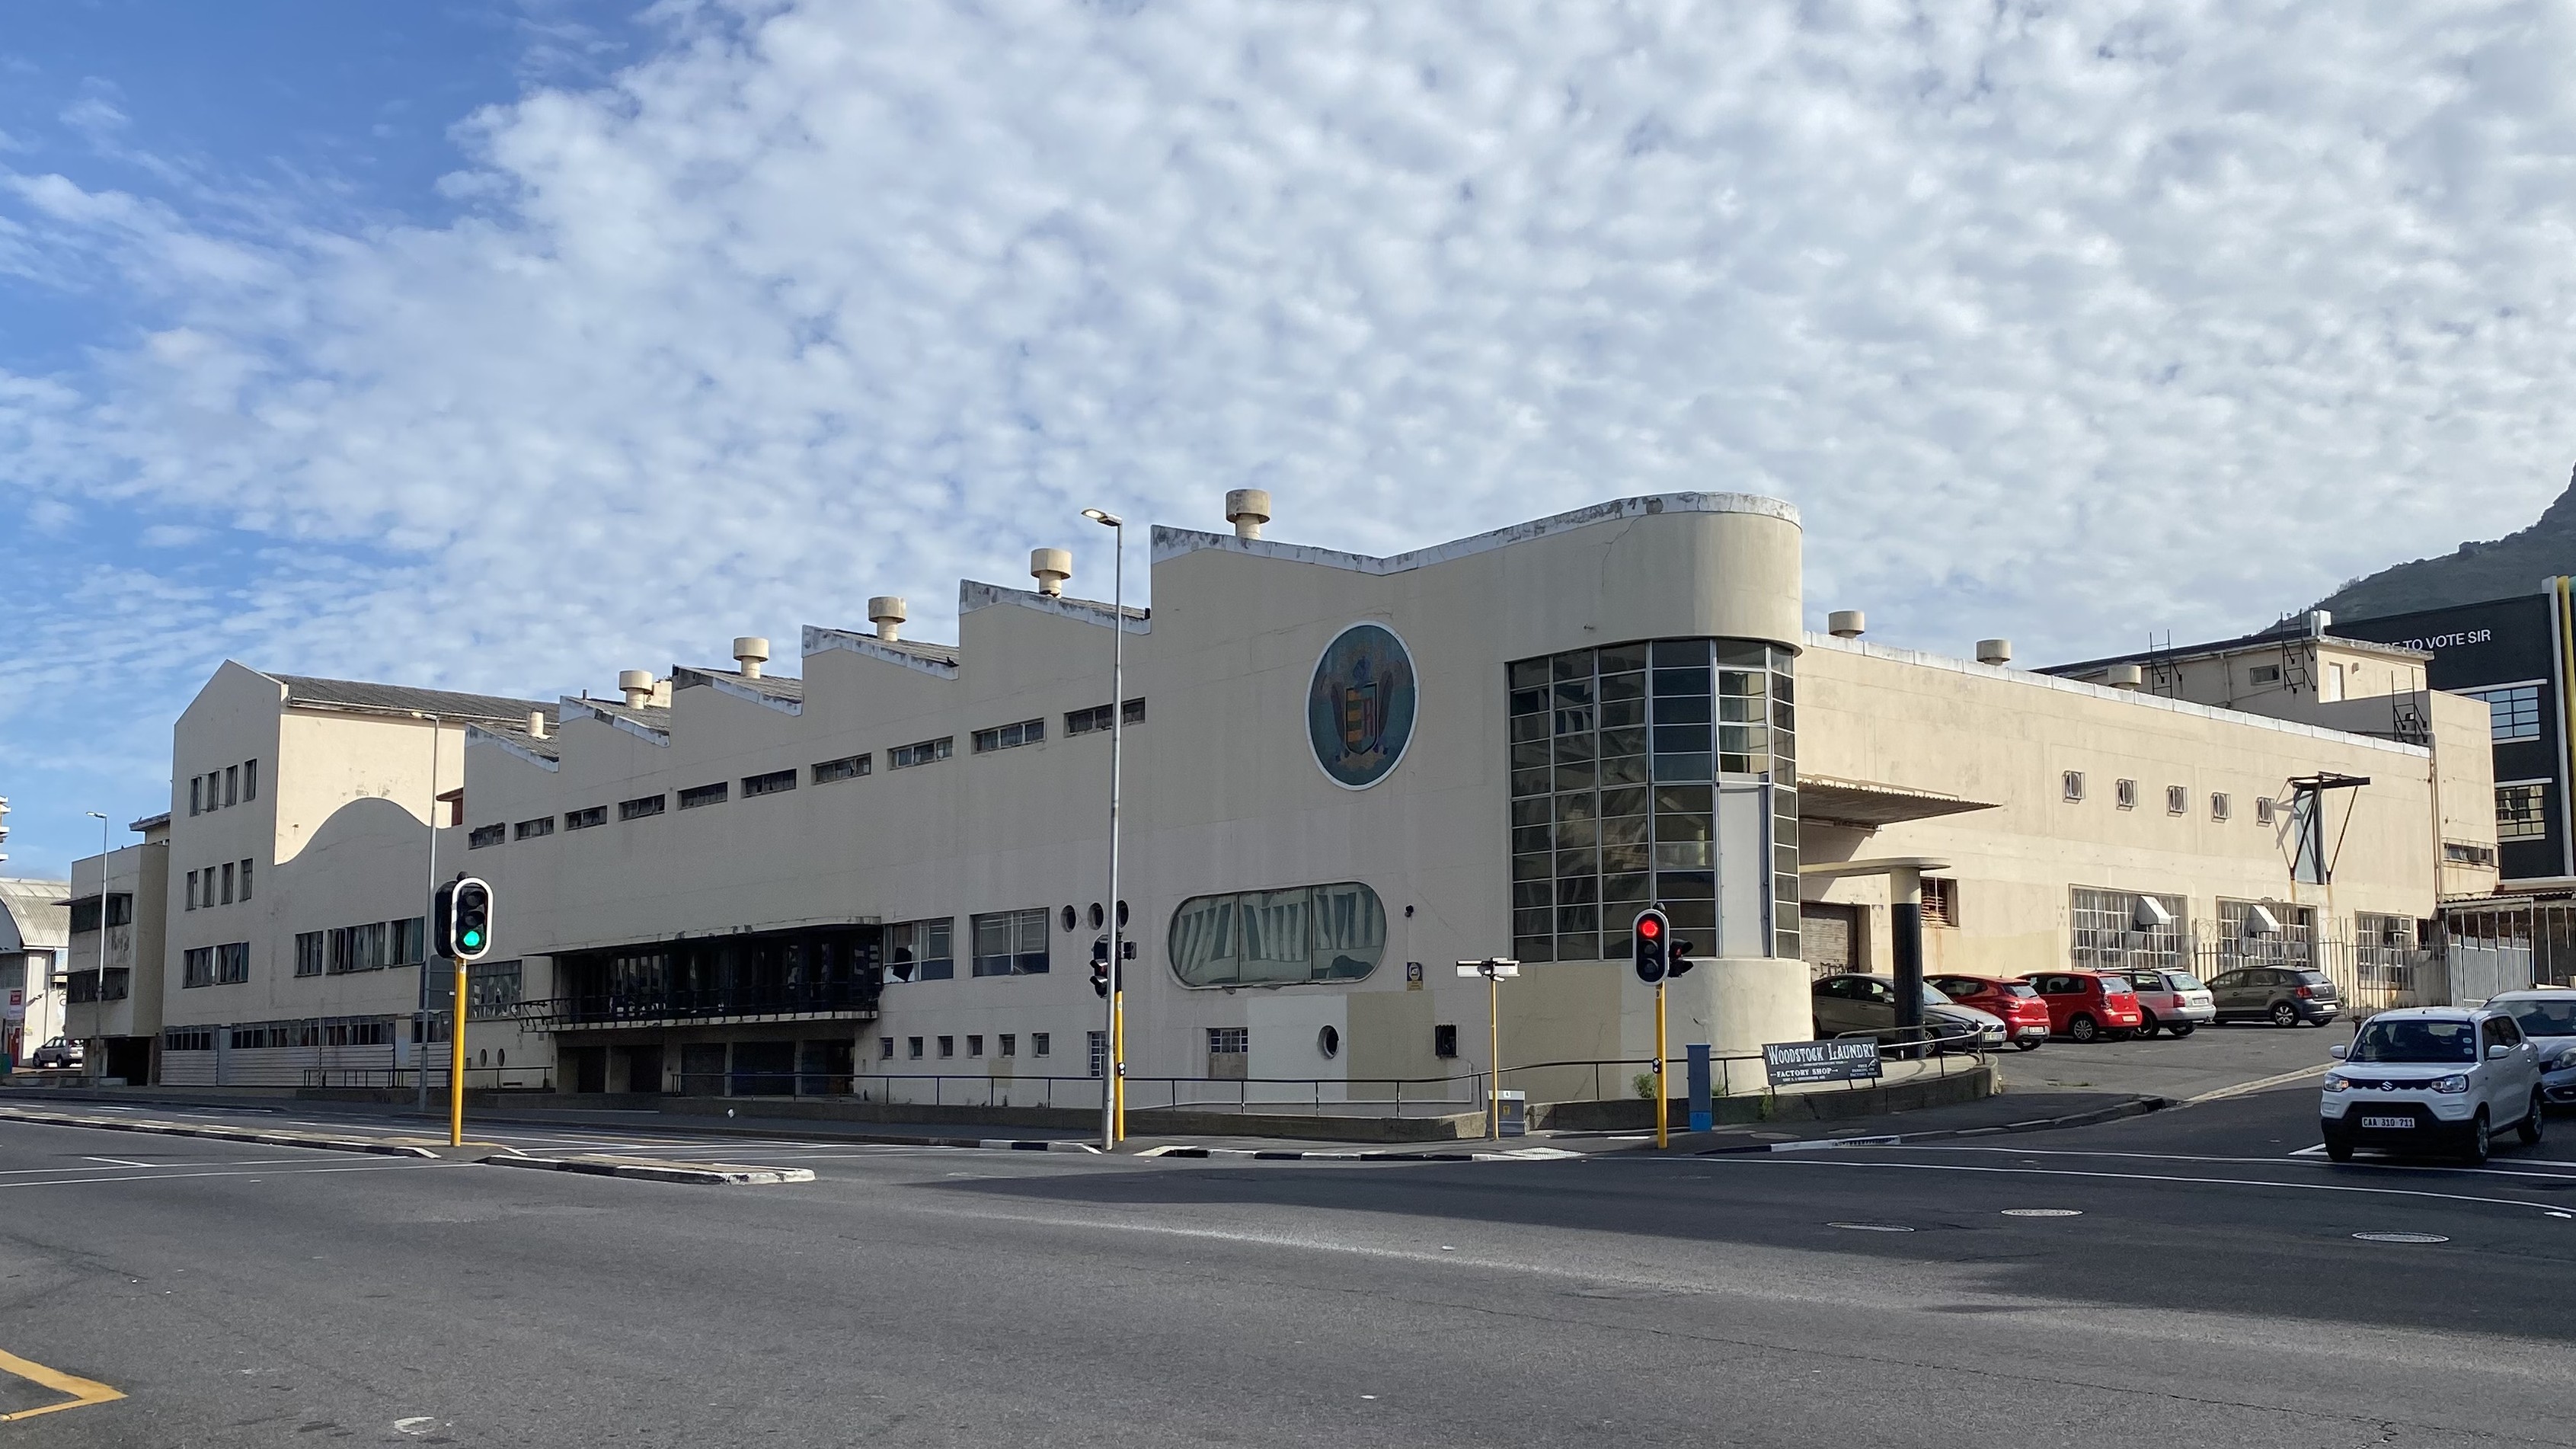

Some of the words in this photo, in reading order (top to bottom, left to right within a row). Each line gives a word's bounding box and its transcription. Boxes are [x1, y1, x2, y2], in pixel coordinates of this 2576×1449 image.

[2425, 632, 2466, 649] VOTE
[2468, 629, 2491, 645] SIR
[1767, 1044, 1824, 1065] WOODSTOCK
[1827, 1043, 1875, 1060] LAUNDRY
[1776, 1069, 1809, 1078] FACTORY
[1812, 1067, 1832, 1076] SHOP
[2399, 1118, 2413, 1127] 711
